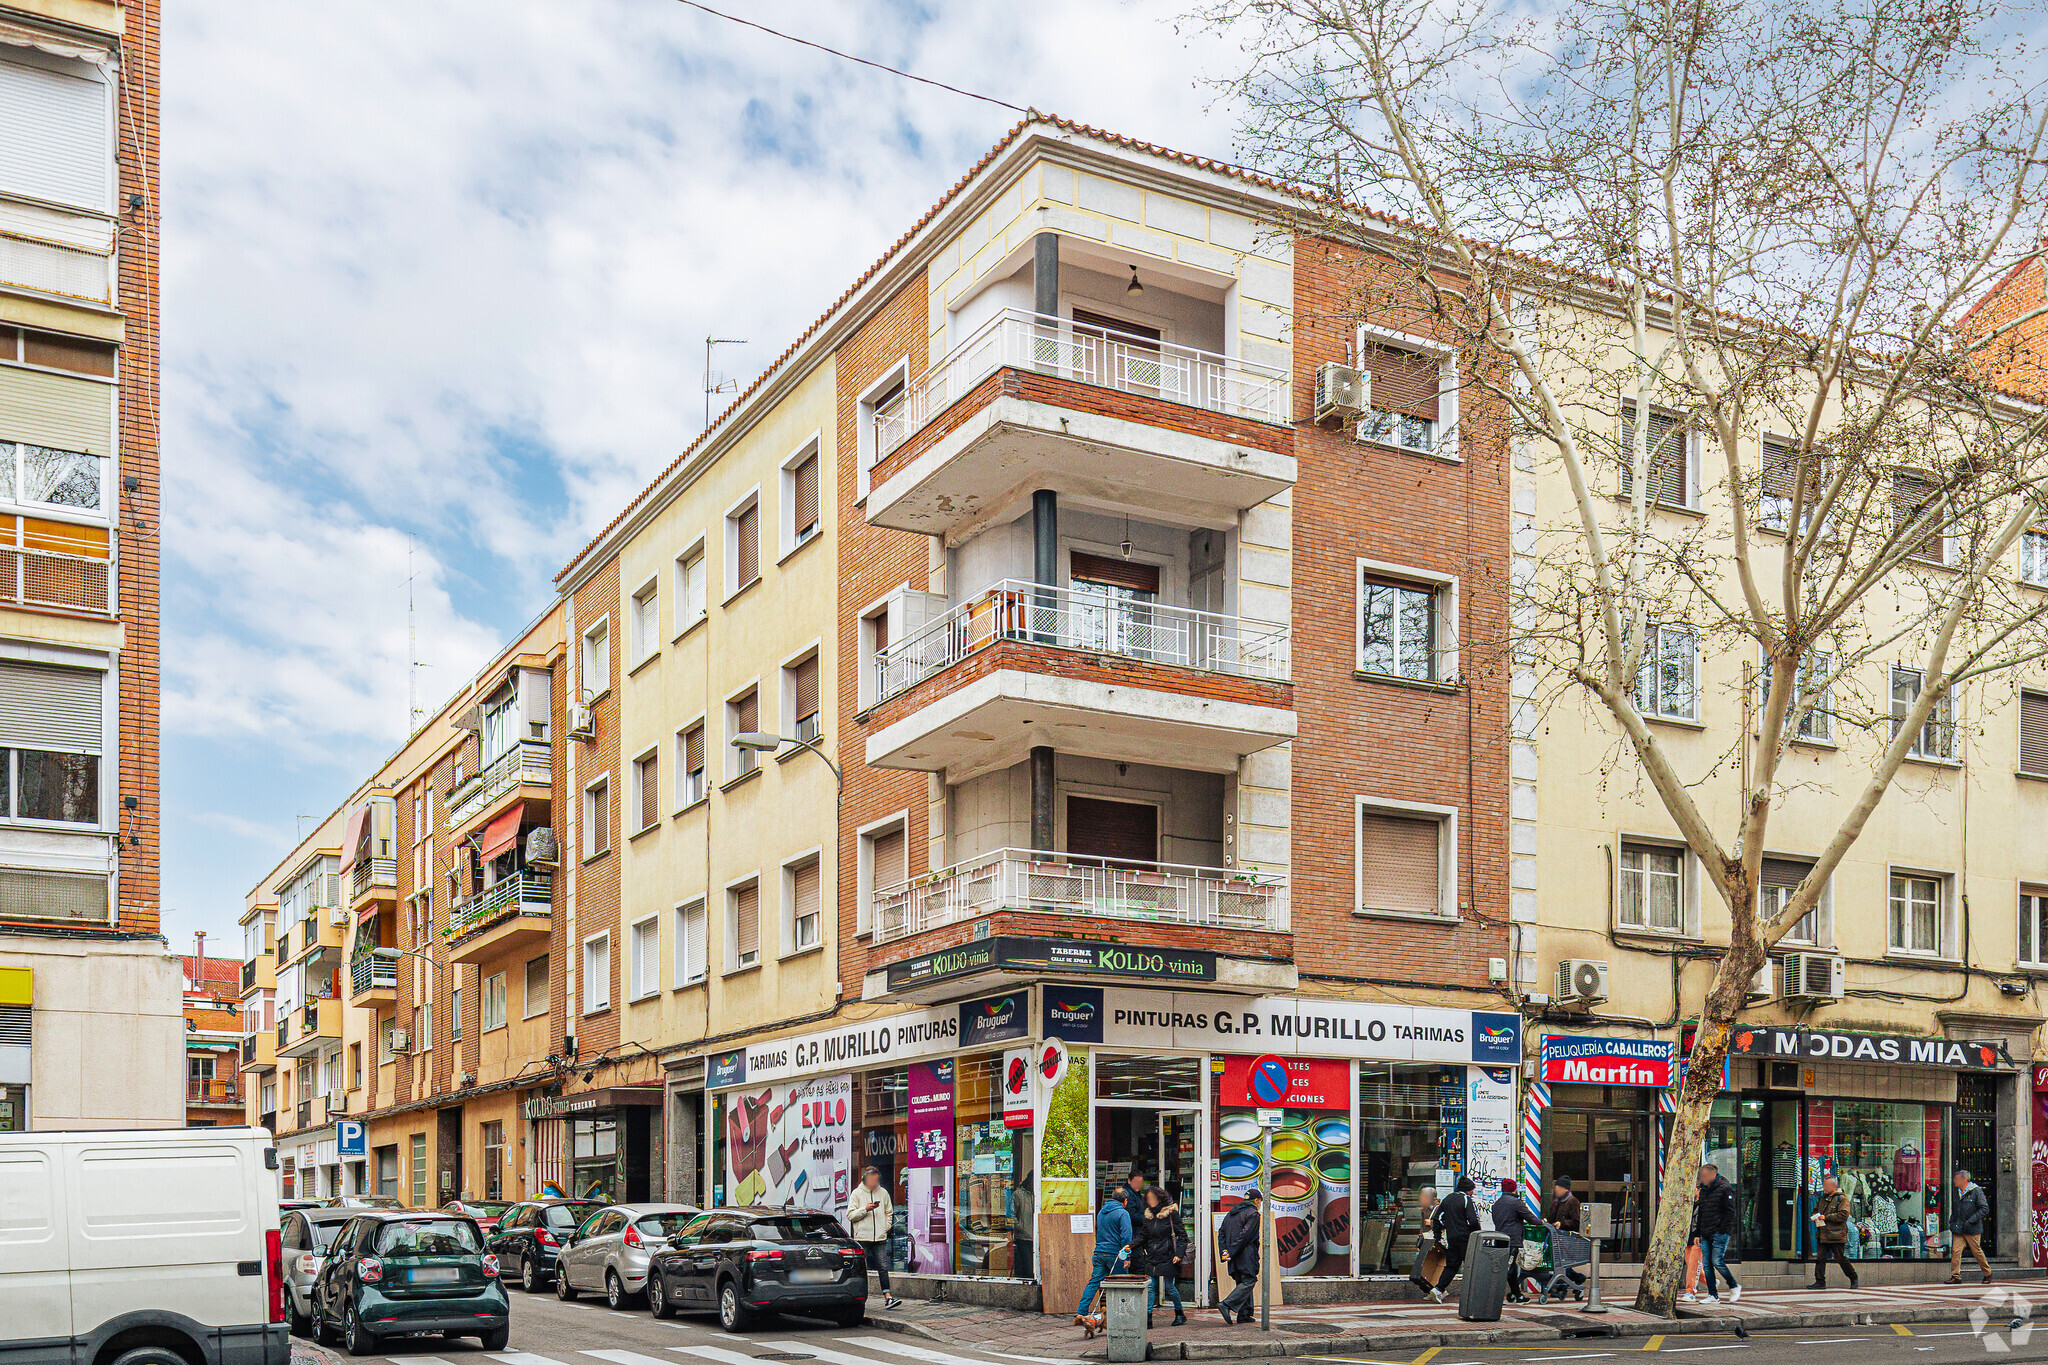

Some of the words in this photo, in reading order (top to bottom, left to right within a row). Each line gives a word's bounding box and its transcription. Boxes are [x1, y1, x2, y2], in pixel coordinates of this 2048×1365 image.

[933, 951, 967, 976] KOLDO
[970, 950, 989, 966] vinia
[1051, 947, 1092, 956] TABERNA
[1098, 948, 1164, 972] KOLDO
[1168, 959, 1204, 975] vinia
[977, 1012, 1012, 1030] Bruguer
[1051, 1009, 1092, 1021] Bruguer
[1114, 1010, 1208, 1028] PINTURAS
[1214, 1011, 1262, 1035] G.P.
[1271, 1014, 1386, 1042] MURILLO
[1393, 1025, 1464, 1042] TARIMAS
[750, 1050, 787, 1072] TARIMAS
[796, 1041, 819, 1068] G.P.
[824, 1027, 890, 1062] MURILLO
[898, 1018, 957, 1046] PINTURAS
[1480, 1033, 1512, 1044] Bruguer
[1549, 1040, 1604, 1058] PELUQUERÍA
[1605, 1042, 1667, 1058] CABALLEROS
[1776, 1032, 1900, 1060] MODAS
[1910, 1041, 1968, 1064] MIA
[1288, 1062, 1310, 1071] LTES
[1563, 1060, 1654, 1084] Martín
[525, 1096, 552, 1120] KOLDO
[570, 1099, 597, 1112] TABERNA
[912, 1094, 930, 1104] COLORES
[933, 1092, 951, 1102] MUNDO
[802, 1098, 847, 1128] RULO
[342, 1122, 362, 1148] P
[1277, 1208, 1316, 1256] ANLUX
